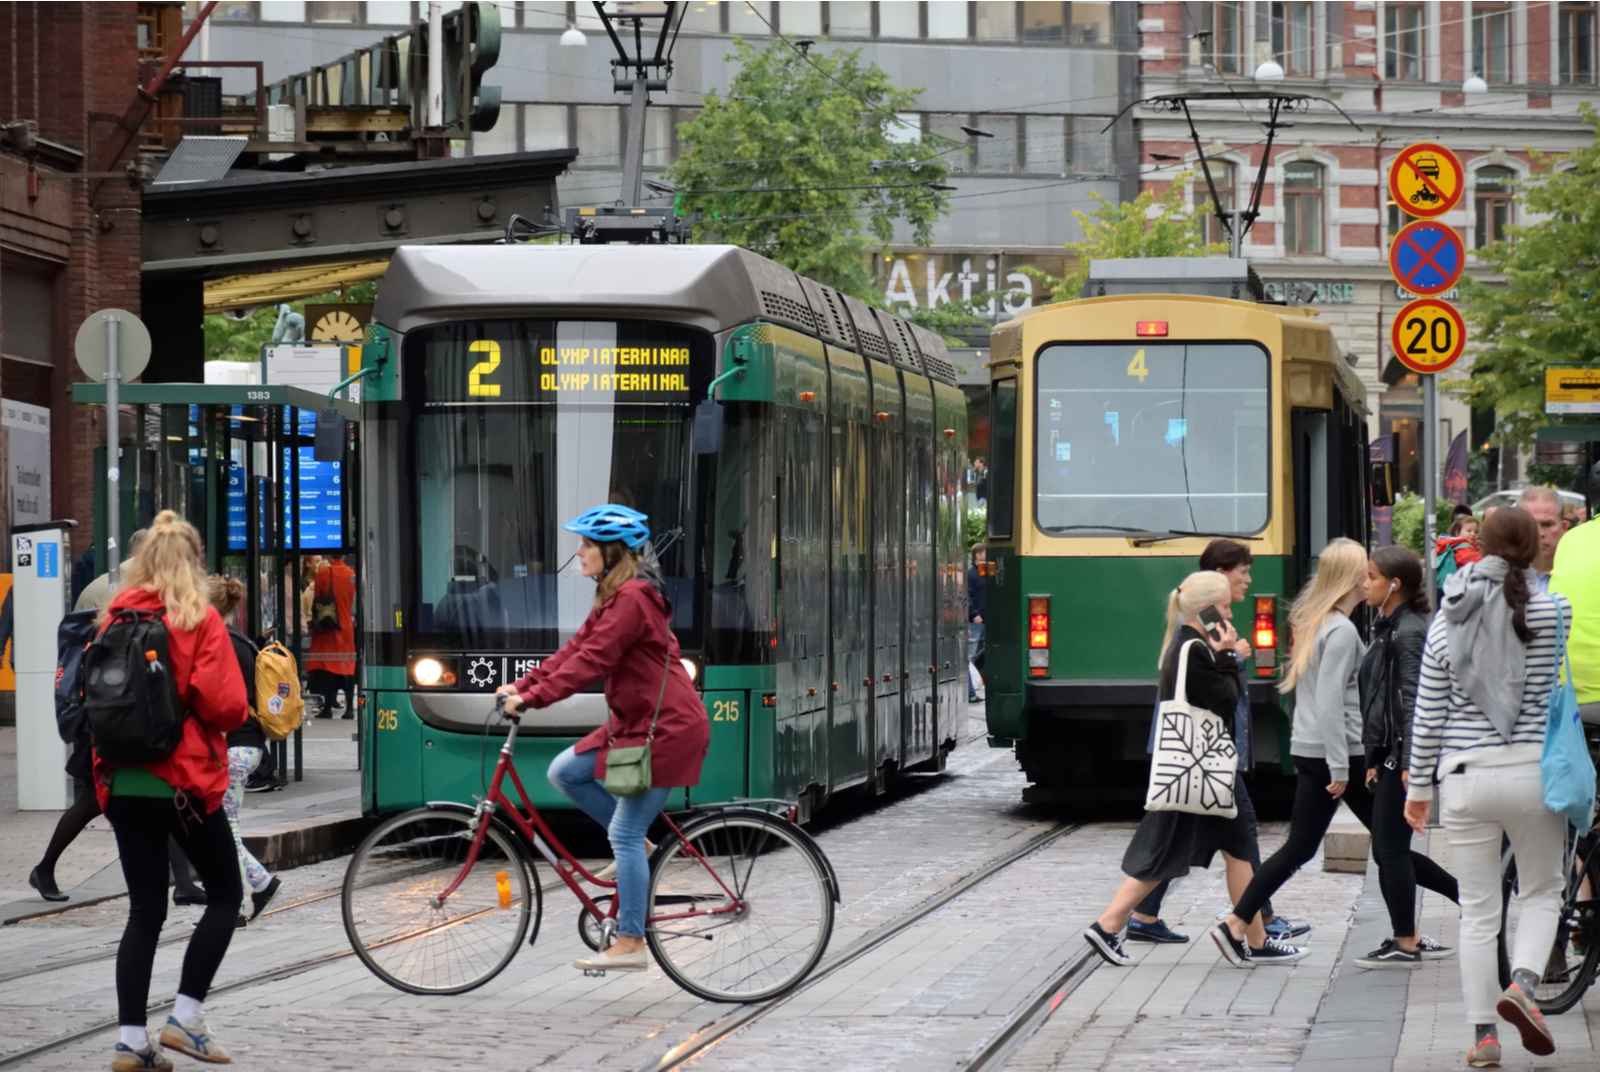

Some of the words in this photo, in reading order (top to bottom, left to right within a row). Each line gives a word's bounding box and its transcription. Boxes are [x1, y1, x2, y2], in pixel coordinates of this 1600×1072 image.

[885, 258, 1033, 315] Aktia
[1406, 316, 1452, 354] 20
[467, 340, 501, 397] 2
[1127, 349, 1149, 384] 4
[540, 372, 690, 391] OLYMPIATERMINAL
[247, 391, 271, 401] 1383
[378, 709, 398, 730] 215
[713, 700, 739, 721] 215
